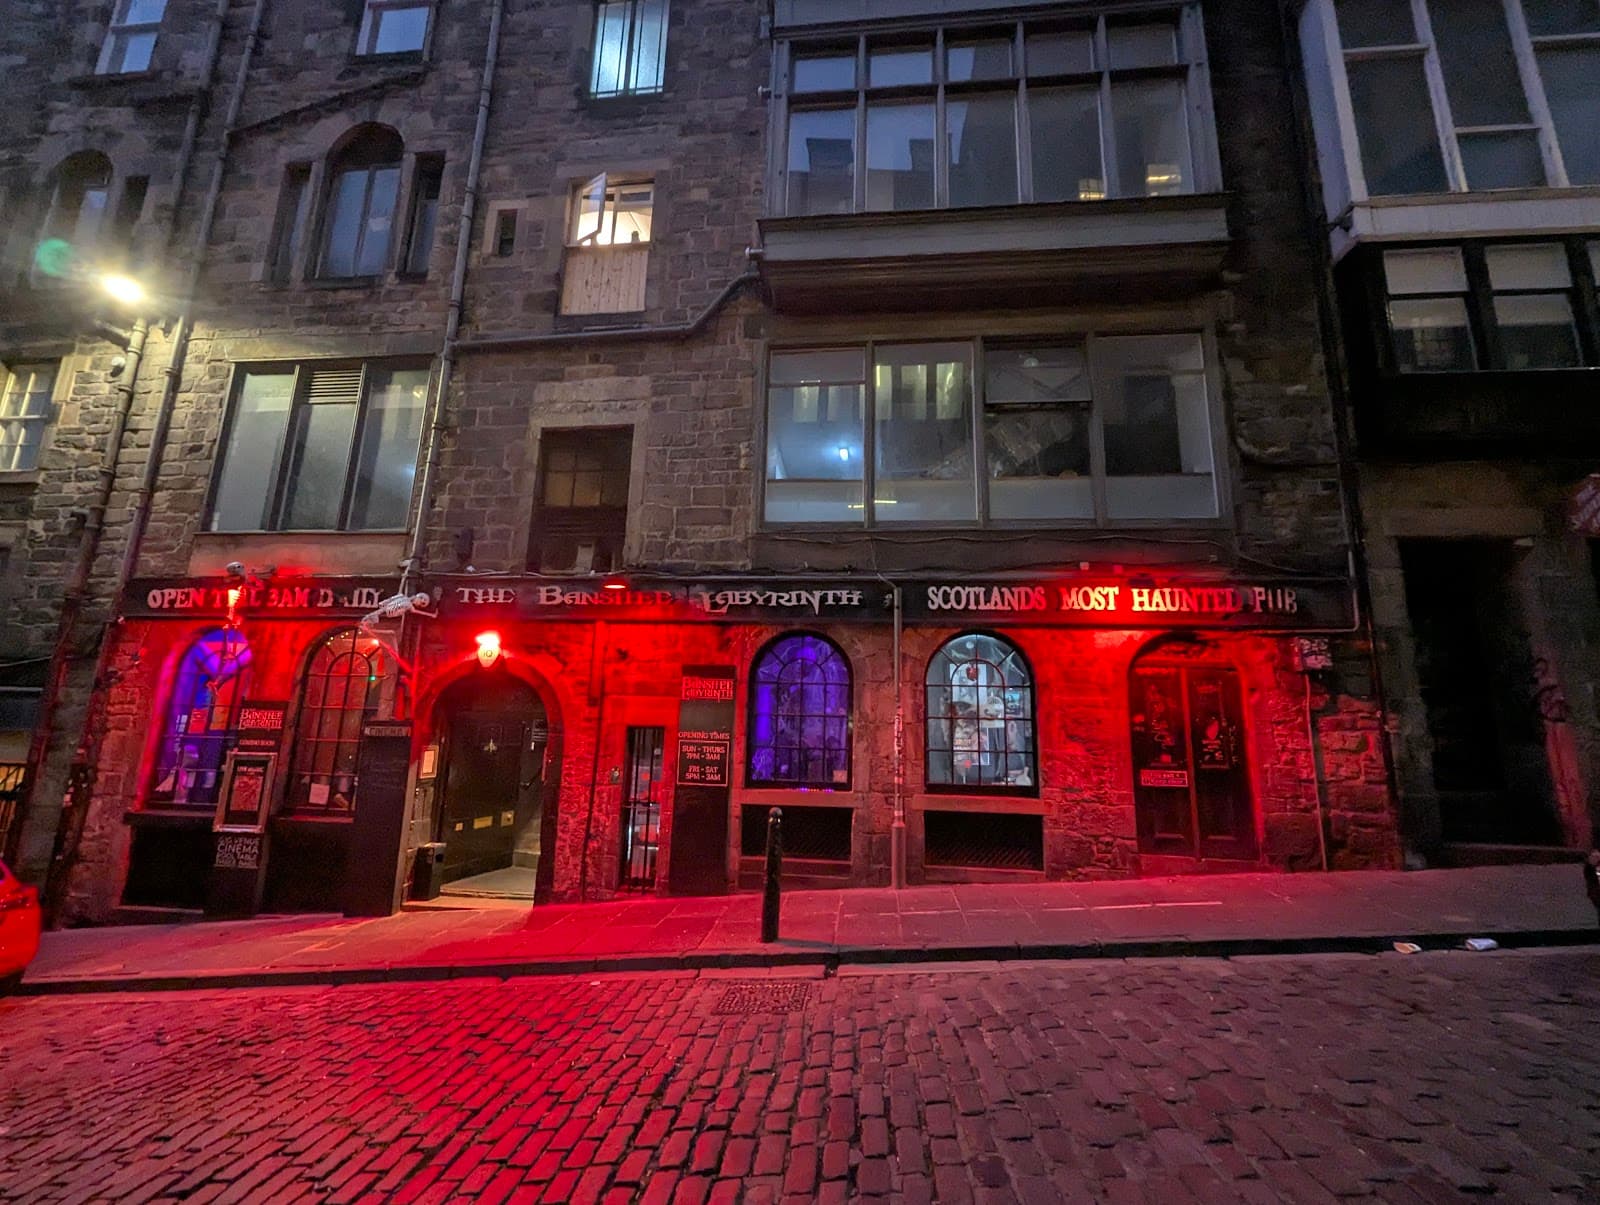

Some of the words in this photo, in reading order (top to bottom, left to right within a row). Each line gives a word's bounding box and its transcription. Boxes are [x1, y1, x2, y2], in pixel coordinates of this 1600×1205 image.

[147, 588, 206, 609] OPEN
[267, 587, 310, 608] 3AM
[456, 586, 516, 604] THE
[699, 590, 861, 616] LABYRINTH
[927, 586, 1047, 611] SCOTLANDS
[1060, 586, 1119, 611] MOST
[1131, 587, 1243, 612] HAUNTED
[1252, 586, 1298, 613] PUB
[678, 731, 708, 739] OPENING
[217, 843, 260, 855] CINEMA
